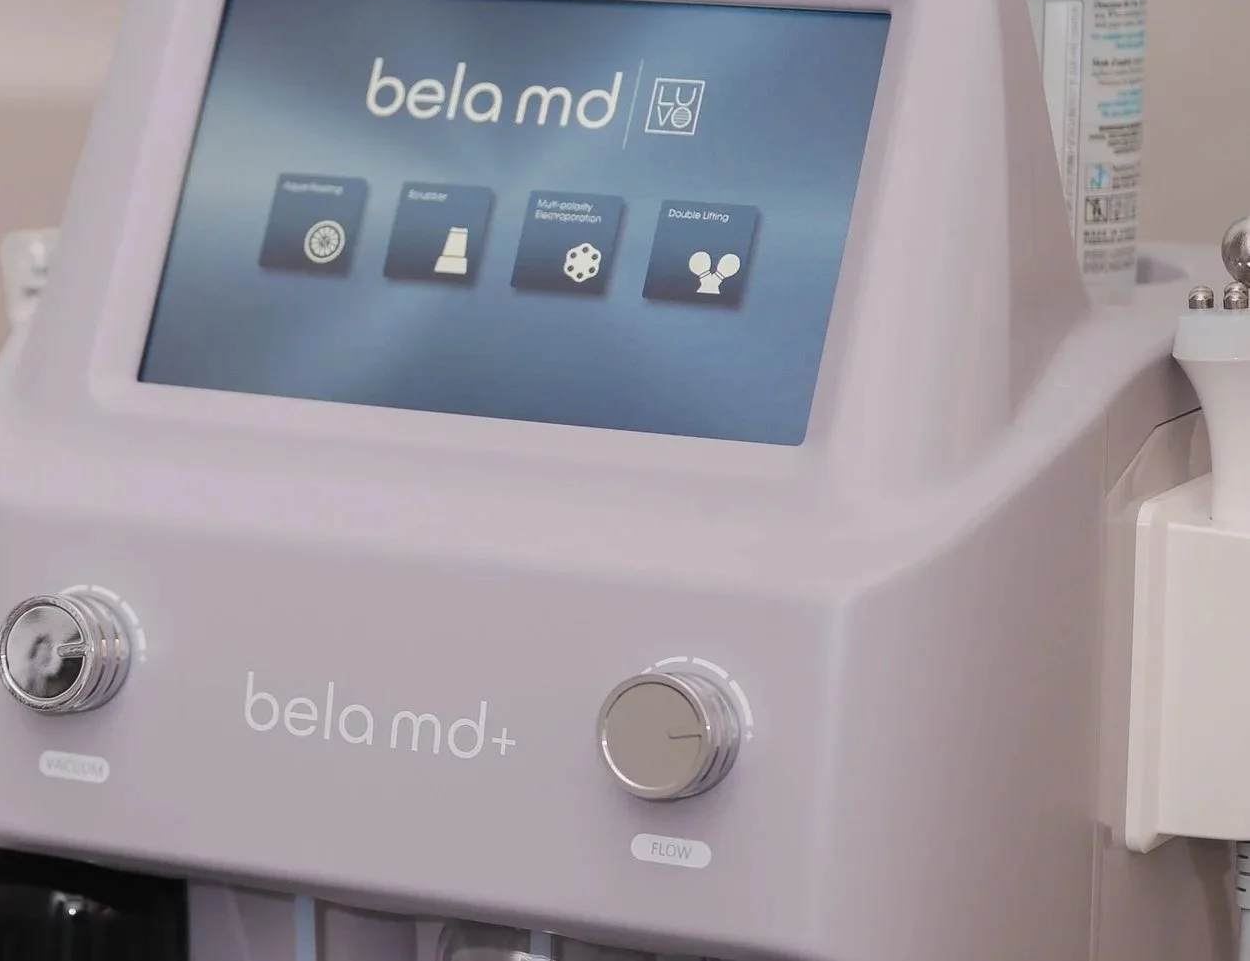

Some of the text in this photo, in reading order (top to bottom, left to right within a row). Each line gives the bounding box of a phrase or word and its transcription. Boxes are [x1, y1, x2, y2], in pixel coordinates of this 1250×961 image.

[366, 57, 623, 129] bela md
[668, 208, 730, 223] Double Lifting
[244, 671, 374, 746] bela
[651, 841, 692, 860] FLOW
